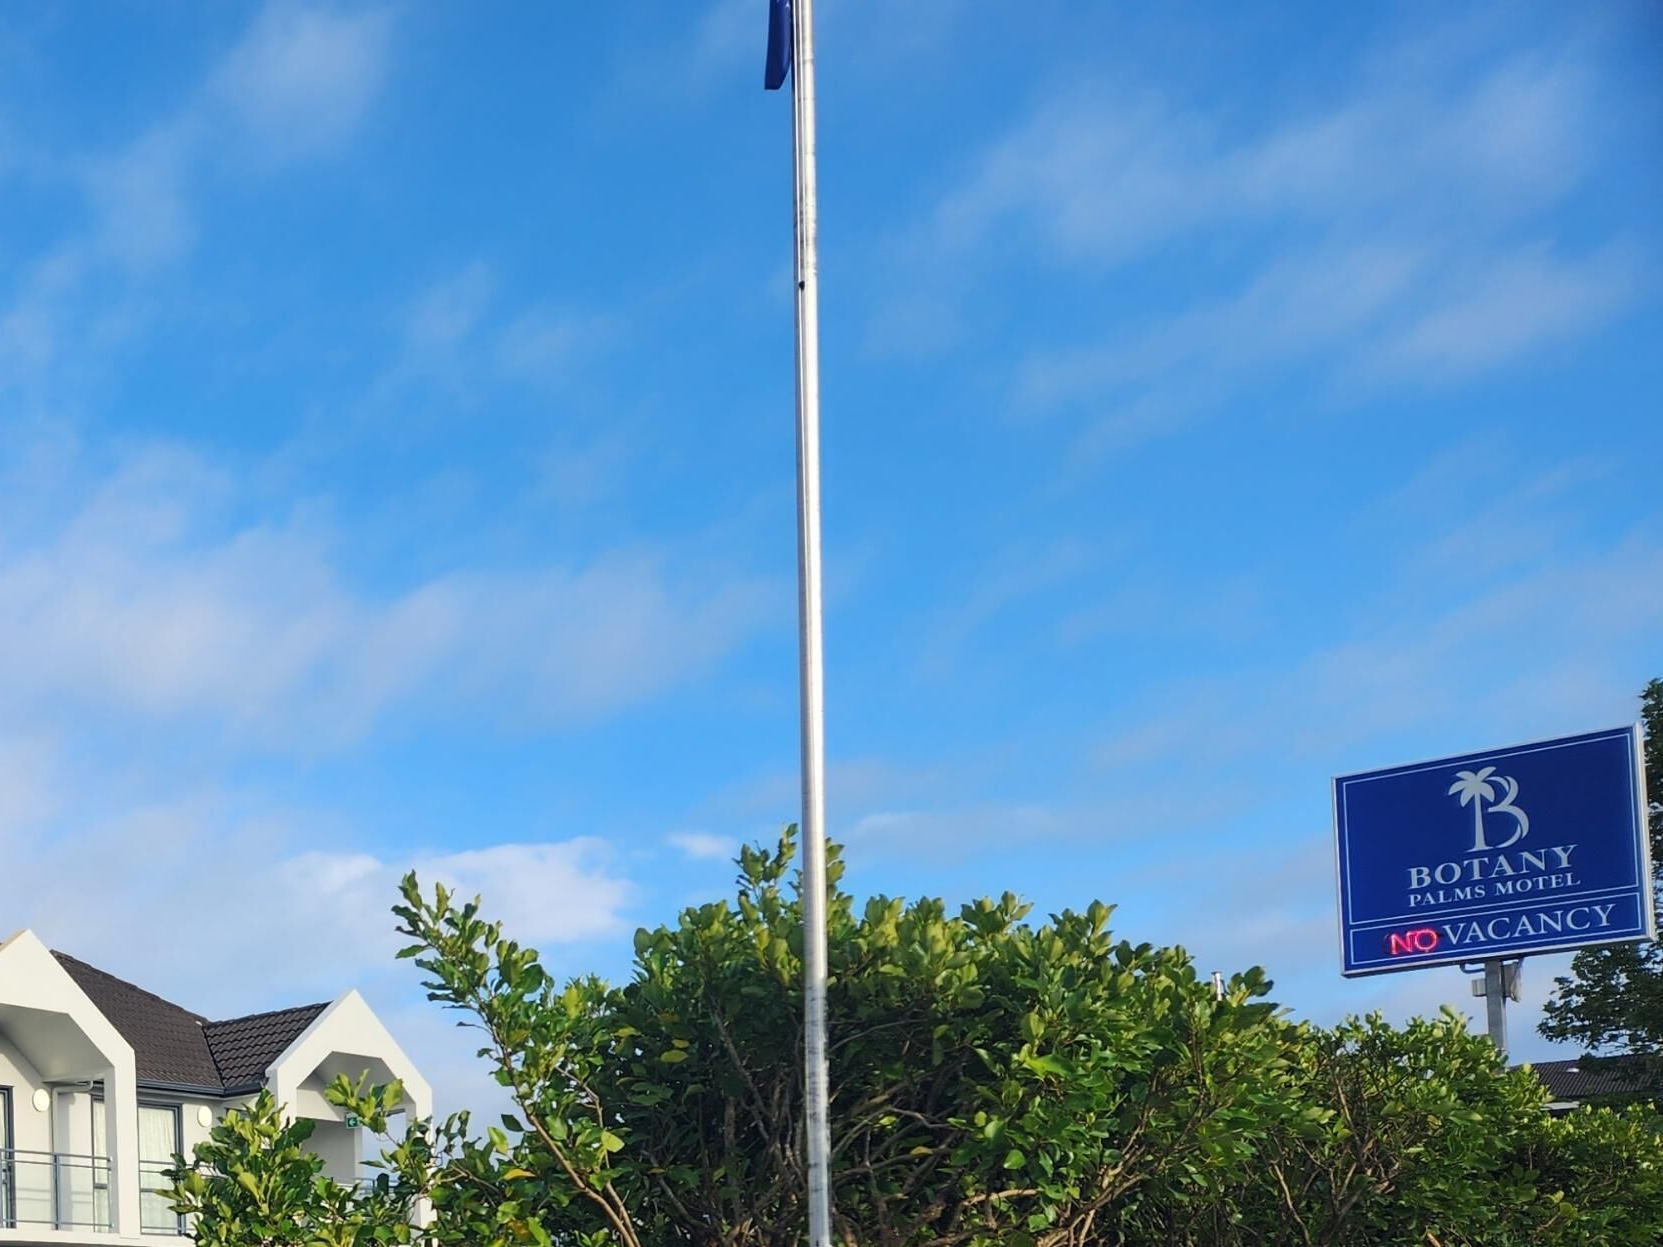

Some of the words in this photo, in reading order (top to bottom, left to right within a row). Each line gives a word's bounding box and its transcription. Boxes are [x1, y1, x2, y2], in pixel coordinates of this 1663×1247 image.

[1407, 845, 1579, 890] BOTANY
[1408, 885, 1486, 908] PALMS
[1495, 872, 1581, 895] MOTEL
[1390, 928, 1438, 955] NO
[1442, 904, 1617, 946] VACANCY
